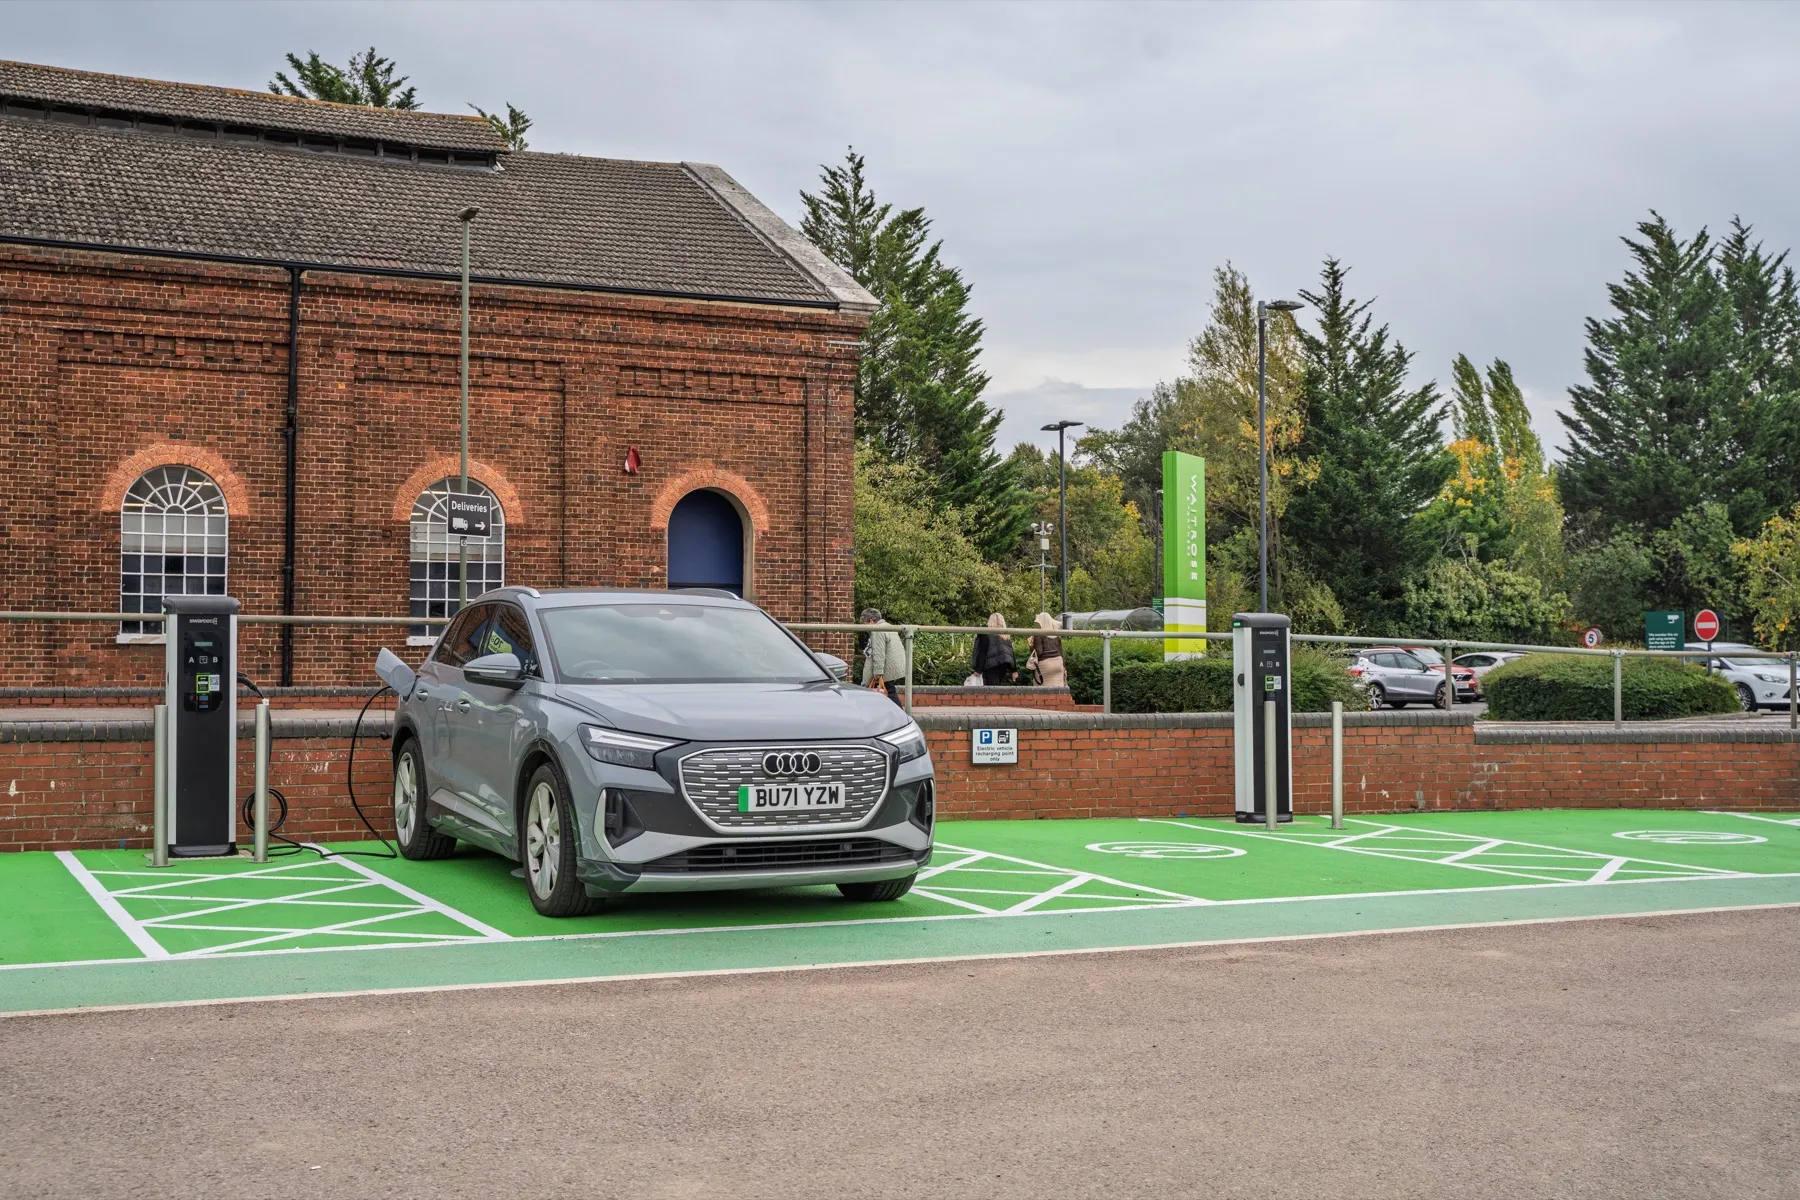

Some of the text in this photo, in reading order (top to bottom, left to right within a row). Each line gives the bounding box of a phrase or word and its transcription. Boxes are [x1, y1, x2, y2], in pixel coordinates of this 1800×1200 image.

[452, 501, 487, 513] Deliveries
[1589, 634, 1594, 643] 5
[982, 732, 990, 743] P
[756, 786, 839, 807] BU71 YZW
